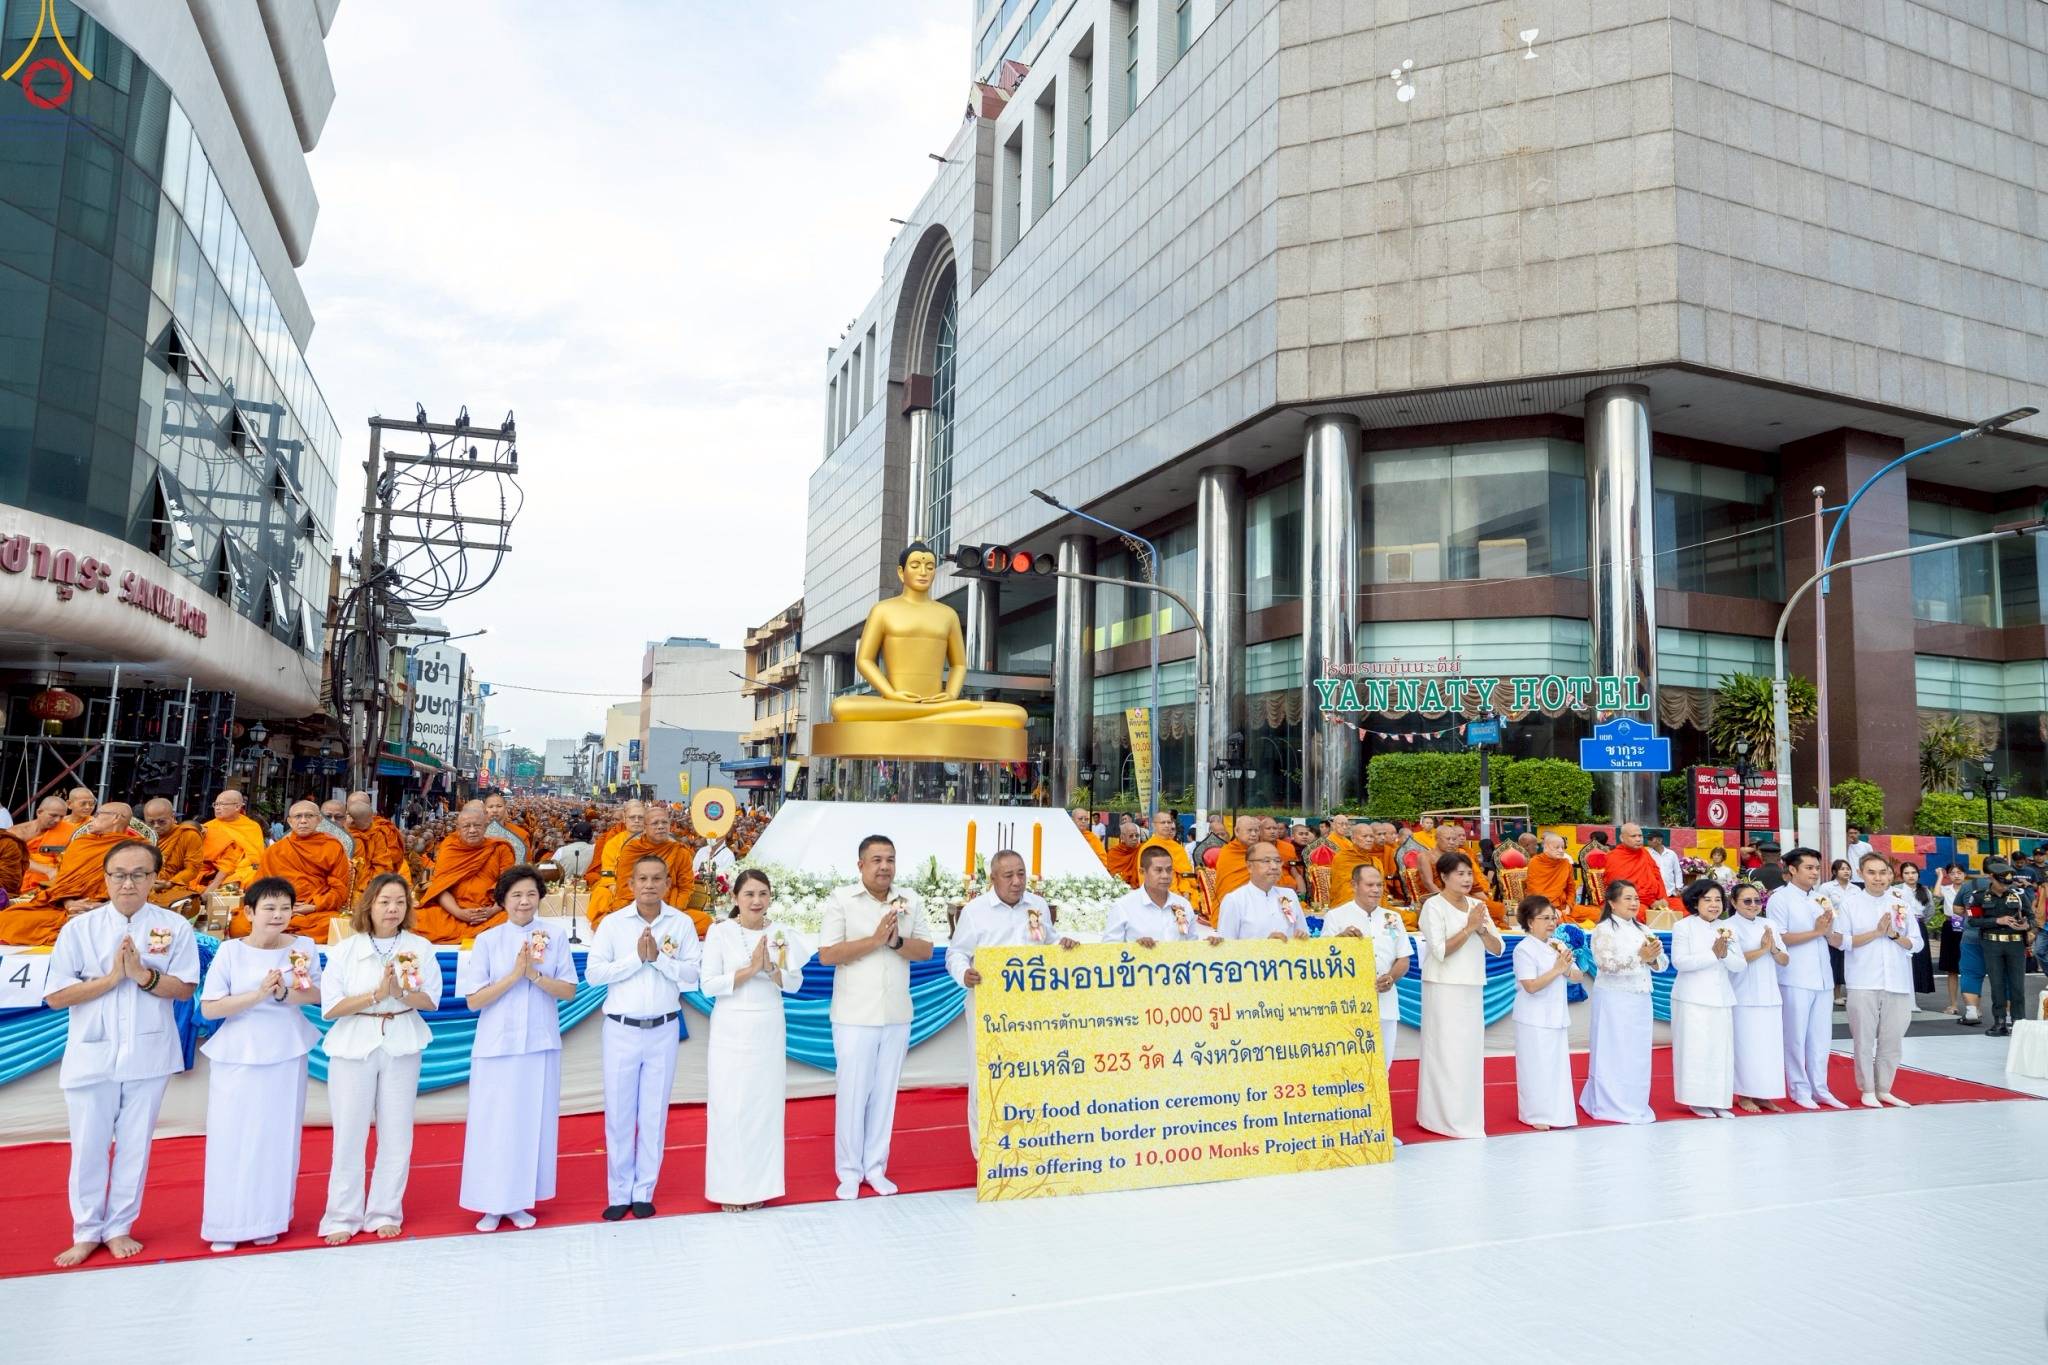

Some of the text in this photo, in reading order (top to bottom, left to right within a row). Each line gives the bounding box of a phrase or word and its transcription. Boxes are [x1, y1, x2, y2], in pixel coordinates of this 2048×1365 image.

[986, 551, 1006, 571] 31
[118, 569, 207, 638] SAKURA HOTEL
[1313, 674, 1650, 712] YANNATY HOTEL
[1132, 743, 1152, 752] 10,00
[1605, 745, 1645, 760] ซากุระ
[1610, 759, 1642, 767] Sakura
[1698, 785, 1709, 795] The
[1749, 788, 1777, 797] Restaurant
[9, 963, 31, 989] 4
[1001, 945, 1356, 992] พิธีมอบข้าวสารอาหารแห้ง
[983, 996, 1373, 1033] ในโครงการตักบาตรพระ 10,000 รูป หาดใหญ่ นานาชาติ ปีที่ 22
[988, 1028, 1376, 1080] ช่วยเหลือ 323 วัด 4 จังหวัดชายแดนภาคใต้
[1003, 1079, 1365, 1123] Dry food donation ceremony for 323 temples
[998, 1104, 1372, 1150] 4 southern border provinces from International
[987, 1129, 1386, 1179] alms offering to 10,000 Monks Project in HatYai
